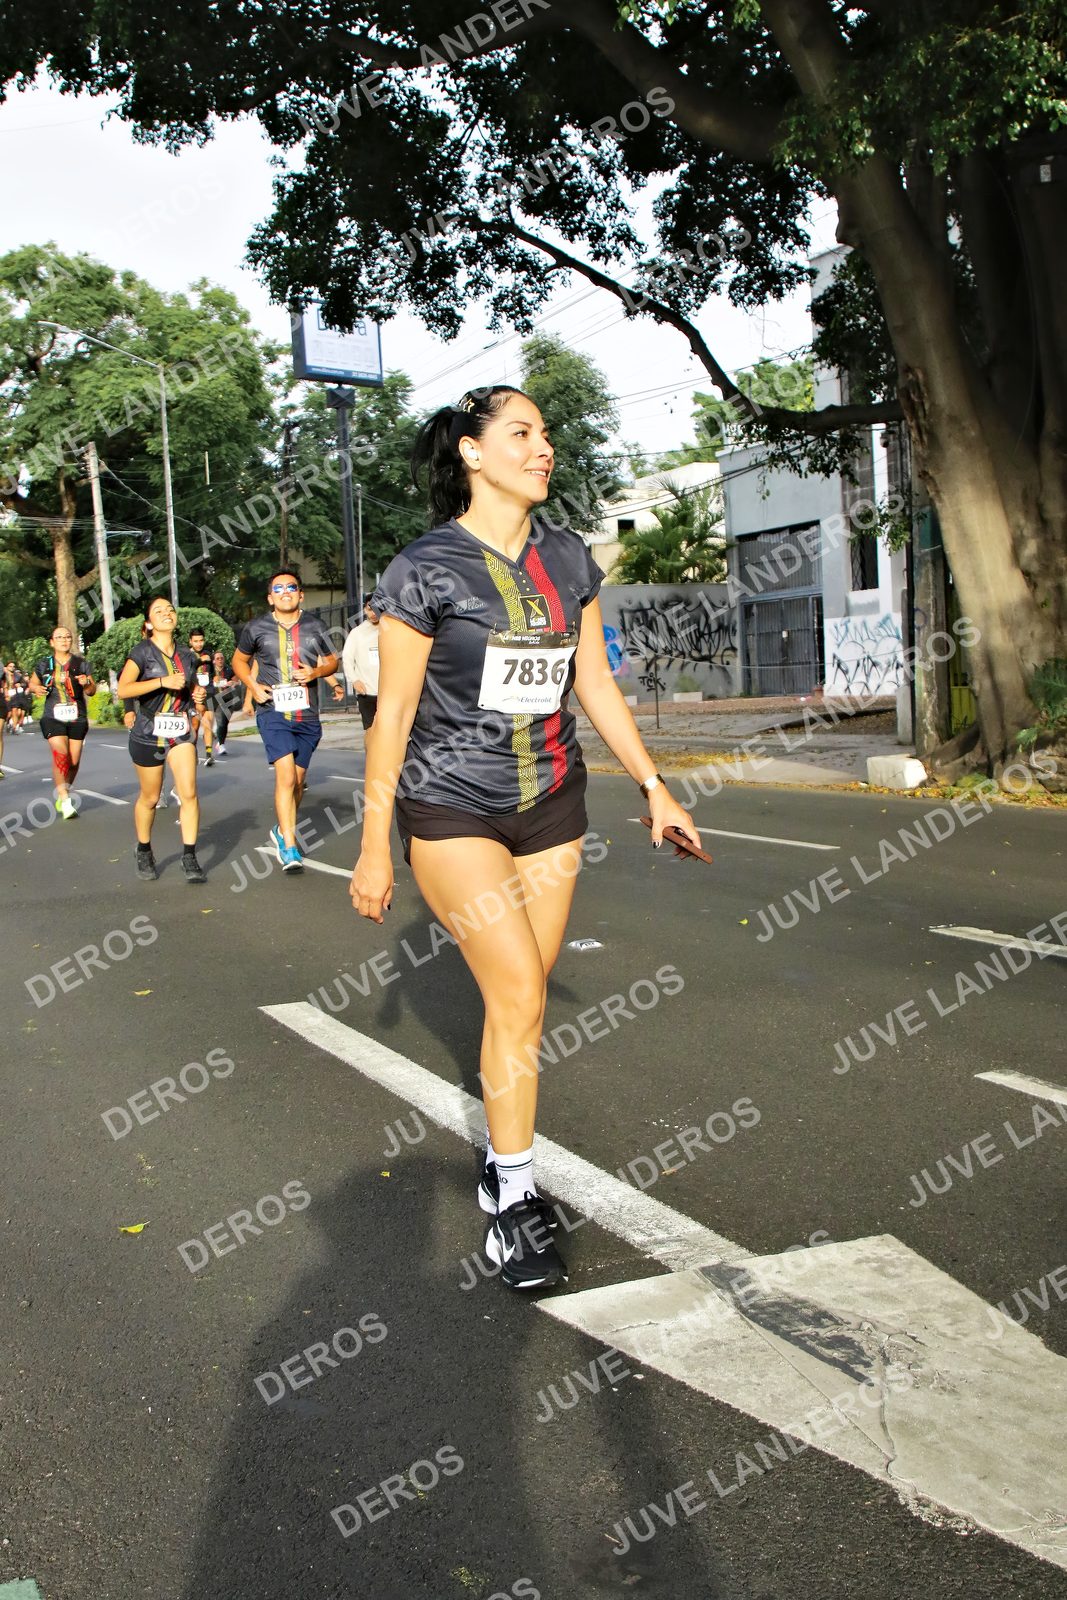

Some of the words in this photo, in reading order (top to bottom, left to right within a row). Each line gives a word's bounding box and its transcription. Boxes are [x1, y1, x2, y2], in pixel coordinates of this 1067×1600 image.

[502, 658, 566, 686] 7836
[275, 690, 304, 702] 11292
[157, 720, 186, 731] 11293
